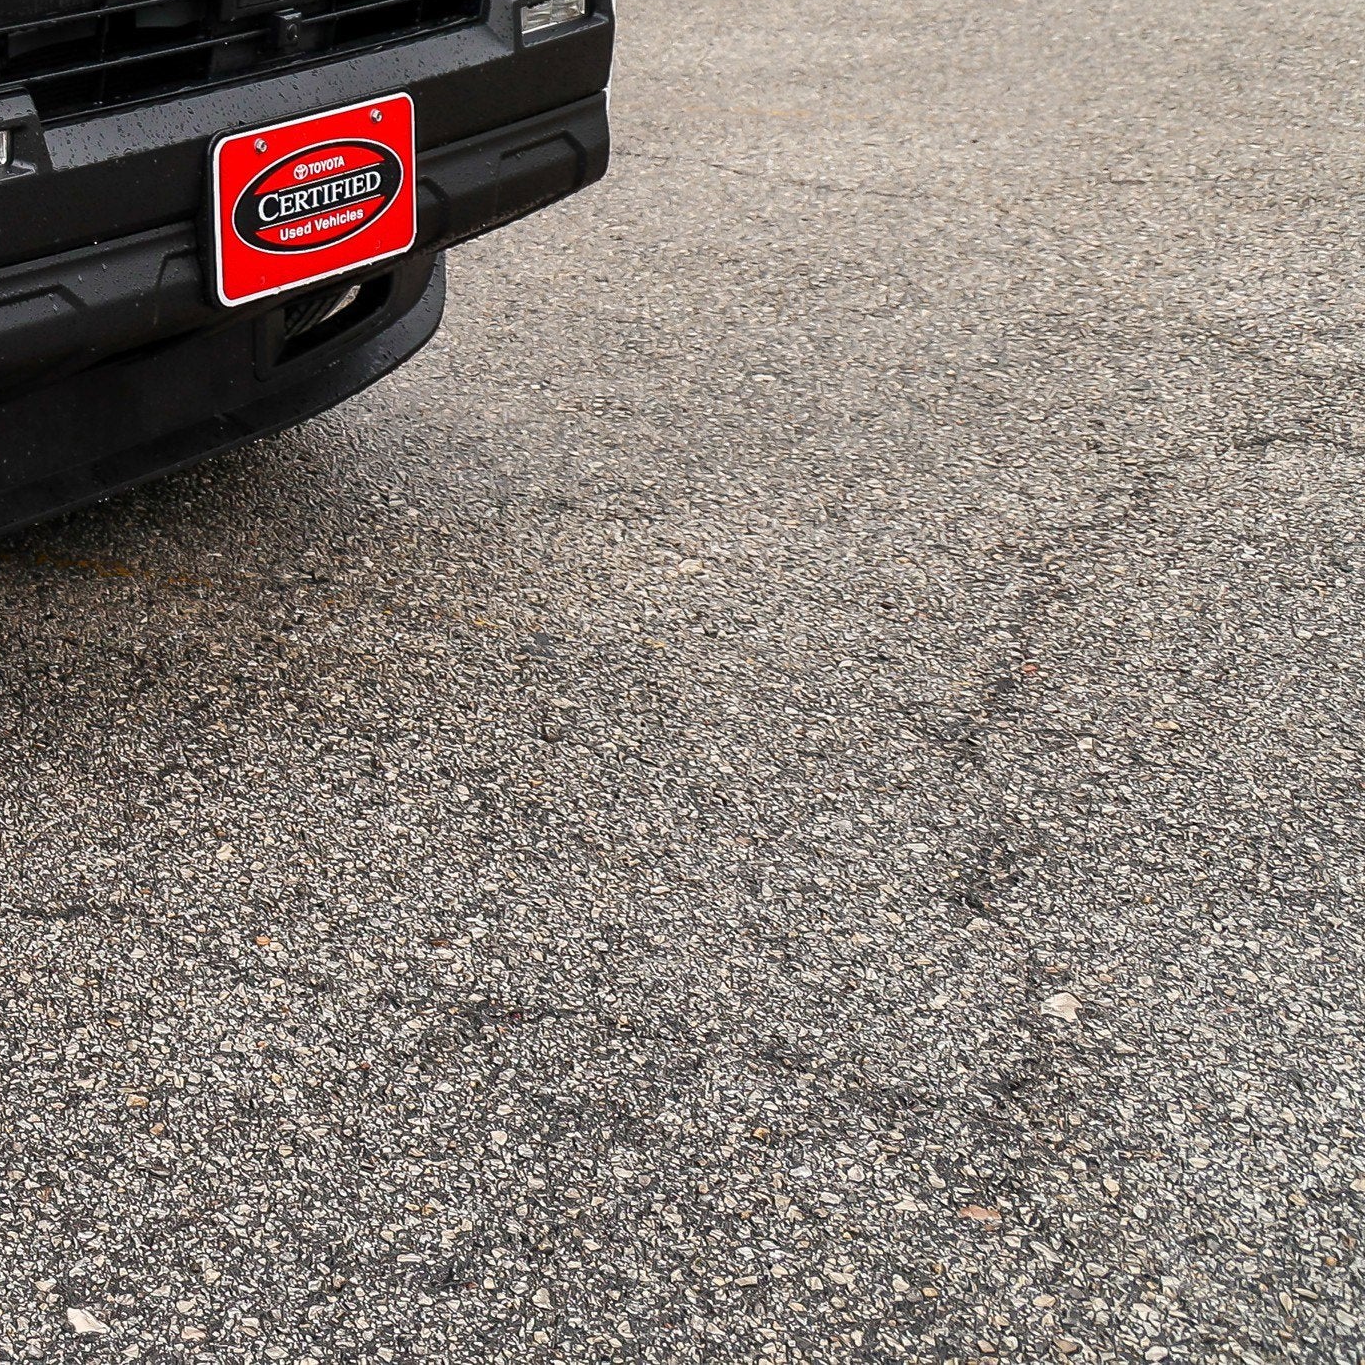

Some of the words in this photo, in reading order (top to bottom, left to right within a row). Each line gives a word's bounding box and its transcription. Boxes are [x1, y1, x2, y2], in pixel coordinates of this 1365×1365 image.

[308, 156, 345, 175] TOYOTA
[258, 171, 382, 221] CERTIFIED
[280, 222, 312, 241] Used
[315, 209, 364, 231] Vehicles
